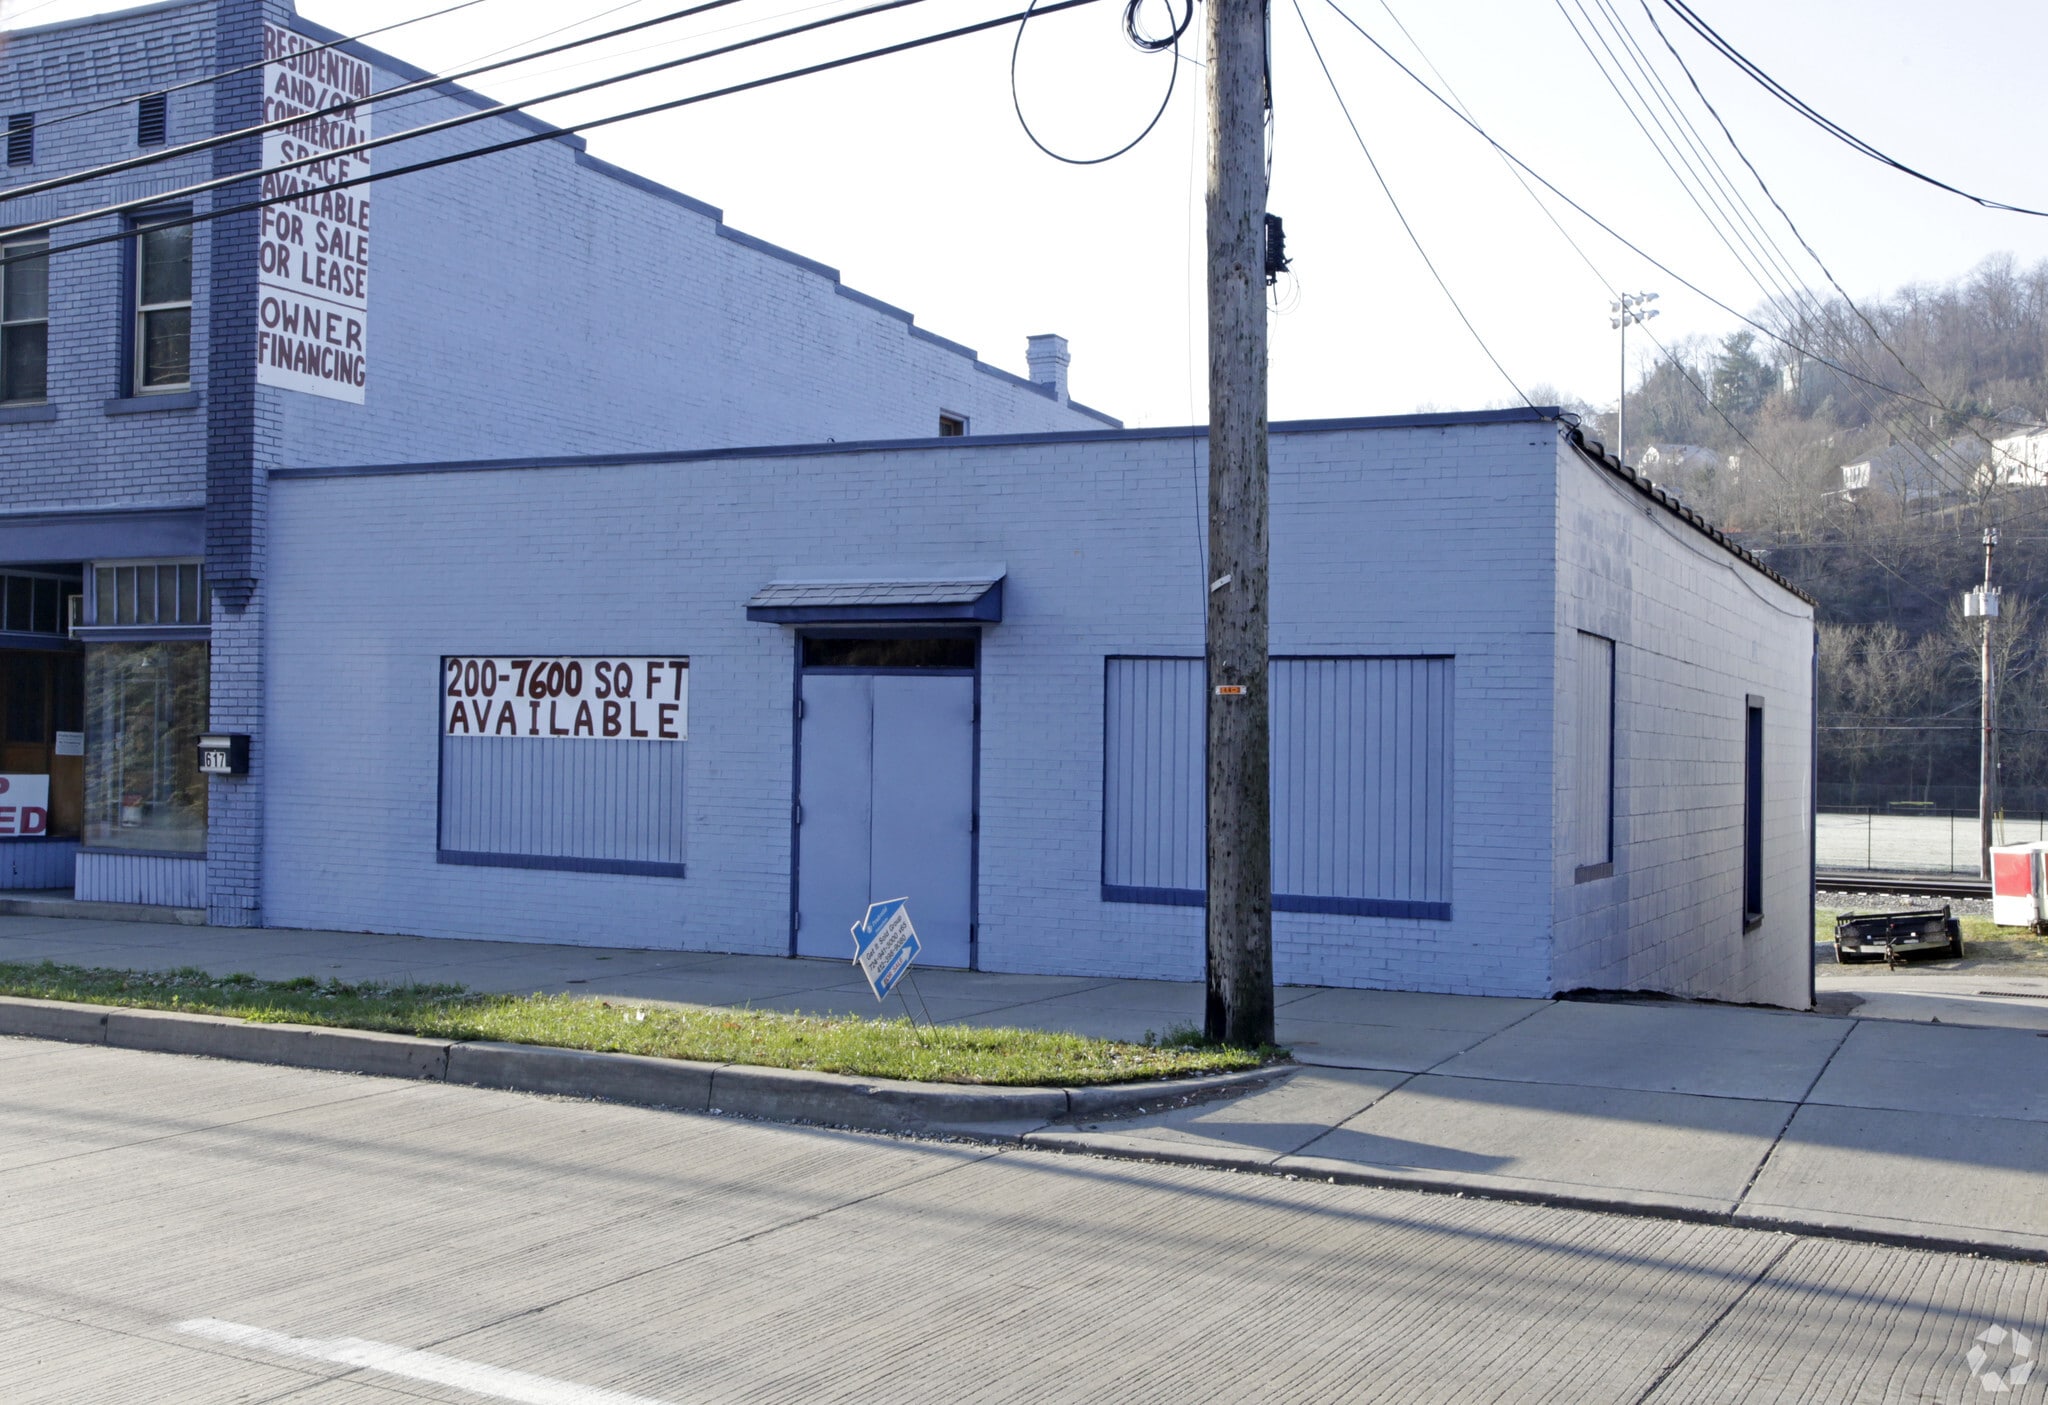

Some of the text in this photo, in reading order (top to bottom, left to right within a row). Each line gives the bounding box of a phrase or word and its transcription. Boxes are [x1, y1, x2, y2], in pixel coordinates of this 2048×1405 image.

[274, 72, 357, 125] AND/OR
[263, 96, 370, 164] COMMERCIAL
[281, 140, 350, 190] SPACE
[262, 171, 369, 232] AVAILABLE
[261, 206, 369, 266] FOR SALE
[260, 241, 367, 299] OR LEASE
[260, 297, 362, 351] OWNER
[258, 331, 365, 387] FINANCING
[447, 659, 690, 701] 200-7600 SQ FT
[449, 700, 680, 739] AVAILABLE
[206, 752, 225, 768] 617
